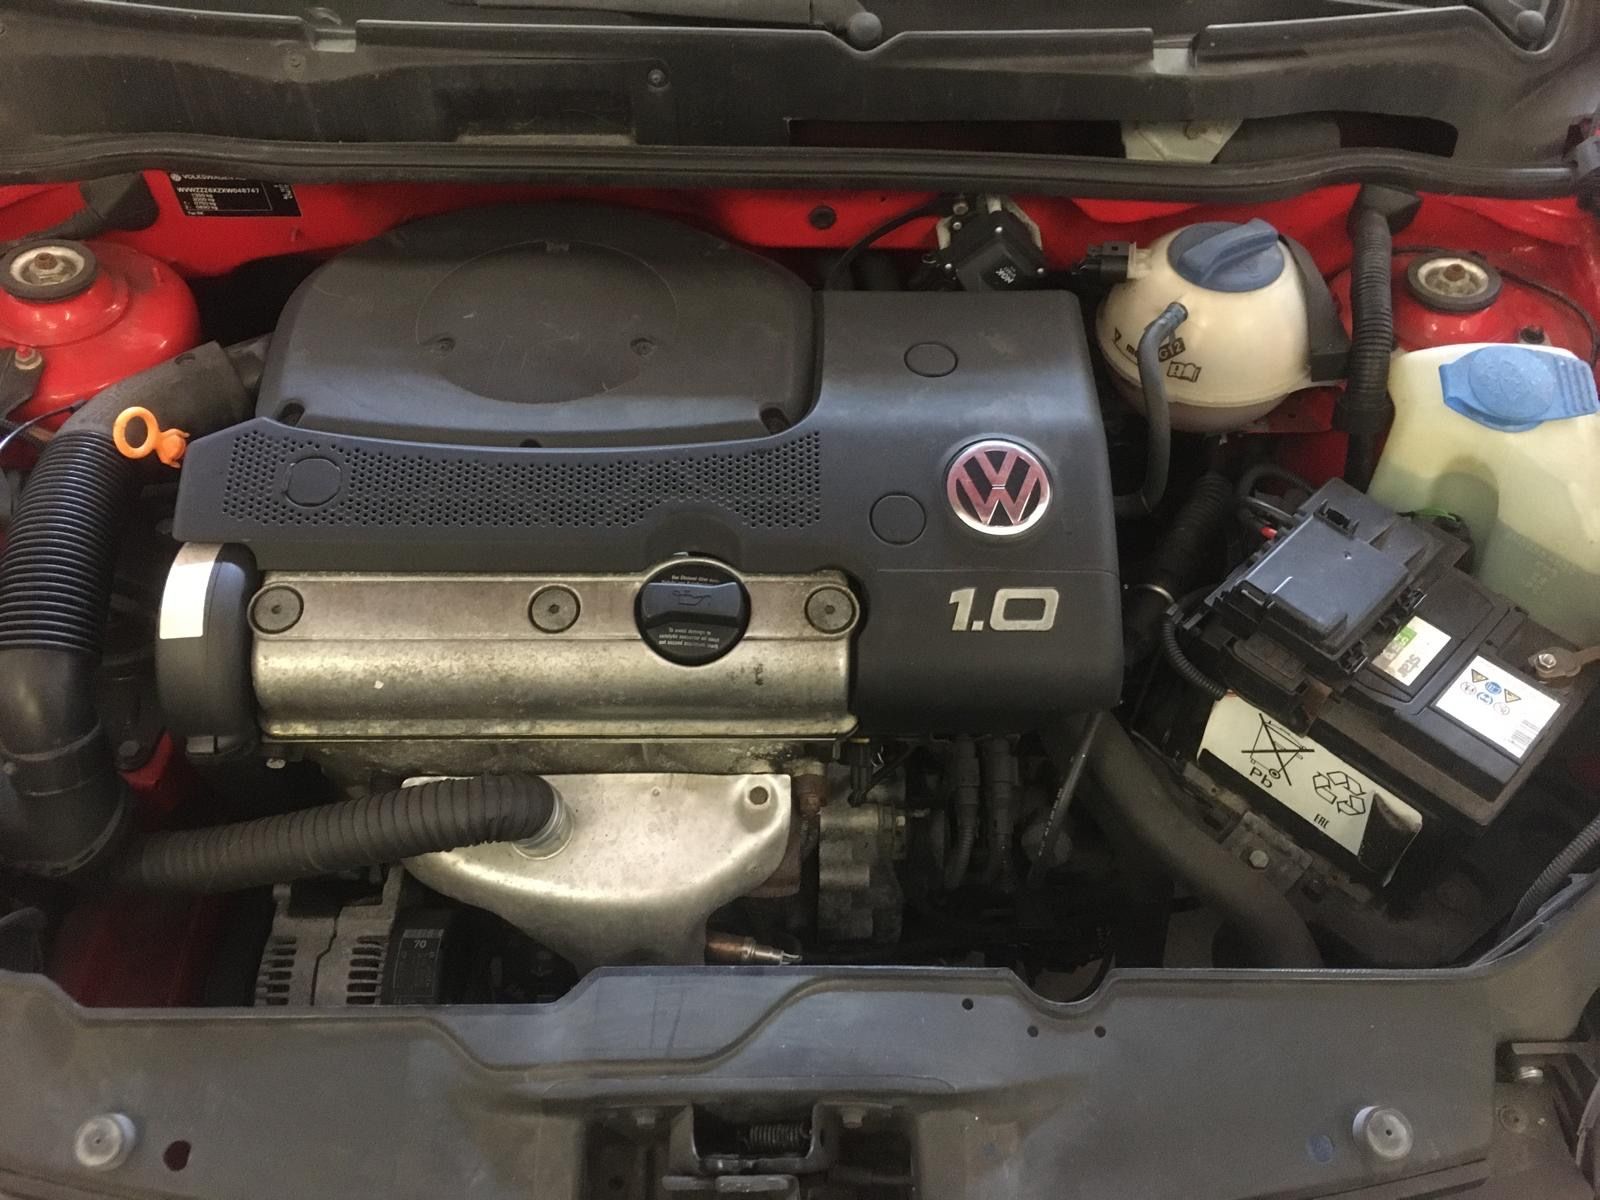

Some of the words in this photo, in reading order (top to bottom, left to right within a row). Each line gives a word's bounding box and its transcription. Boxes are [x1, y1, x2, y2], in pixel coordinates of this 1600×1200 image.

[949, 587, 1060, 631] 1.0
[1249, 766, 1273, 788] Pb
[413, 939, 427, 949] 70
